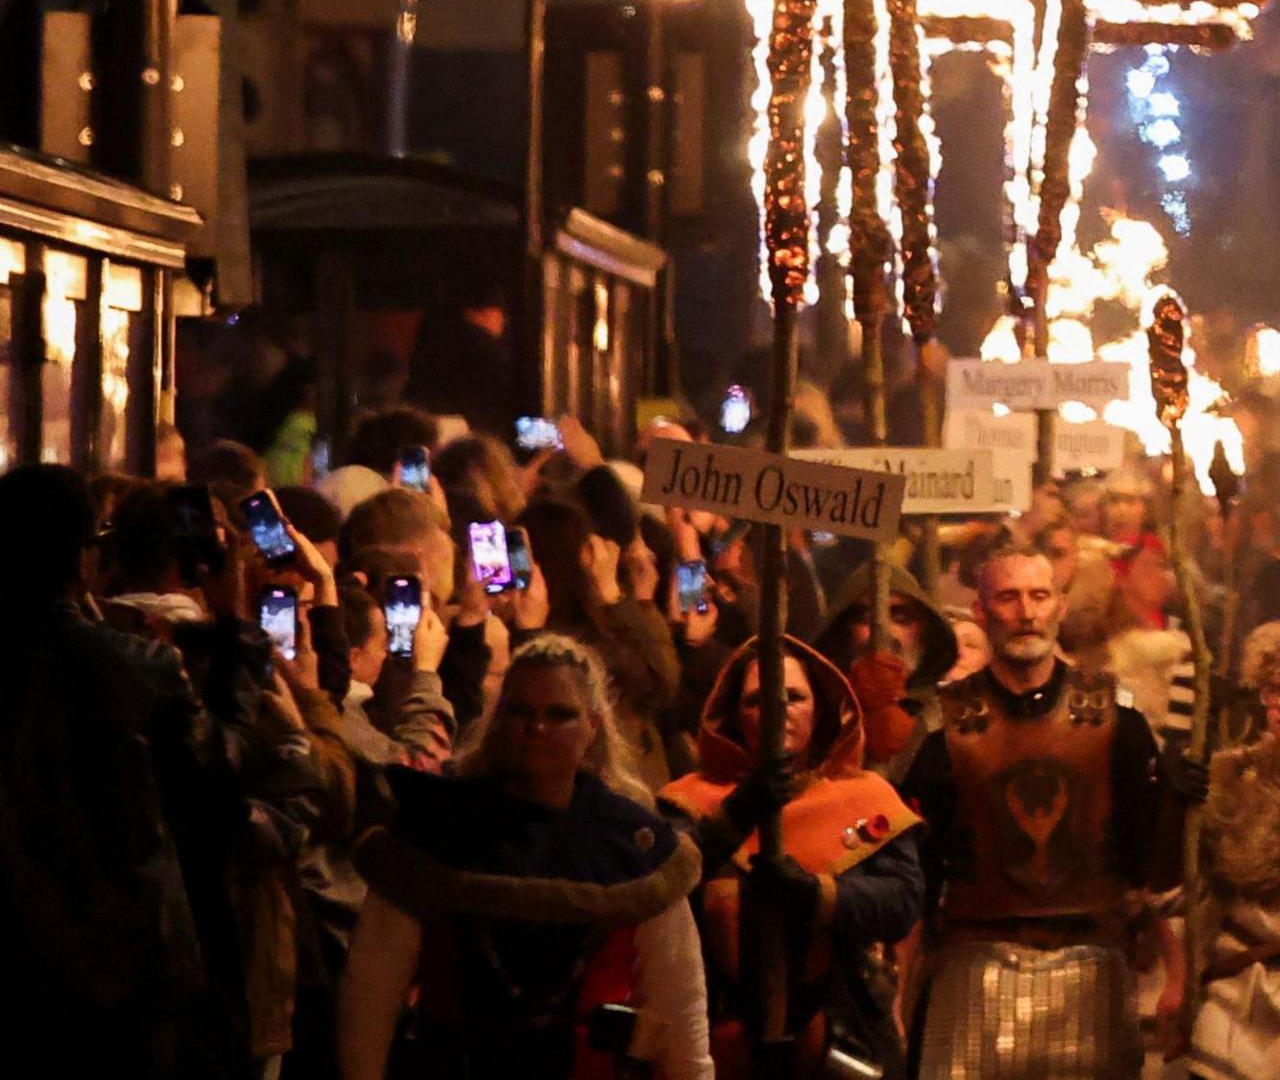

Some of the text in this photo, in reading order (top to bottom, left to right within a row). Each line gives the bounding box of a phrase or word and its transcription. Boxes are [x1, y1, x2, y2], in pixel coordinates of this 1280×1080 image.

[662, 448, 886, 529] John Oswald
[884, 459, 974, 499] ainard
